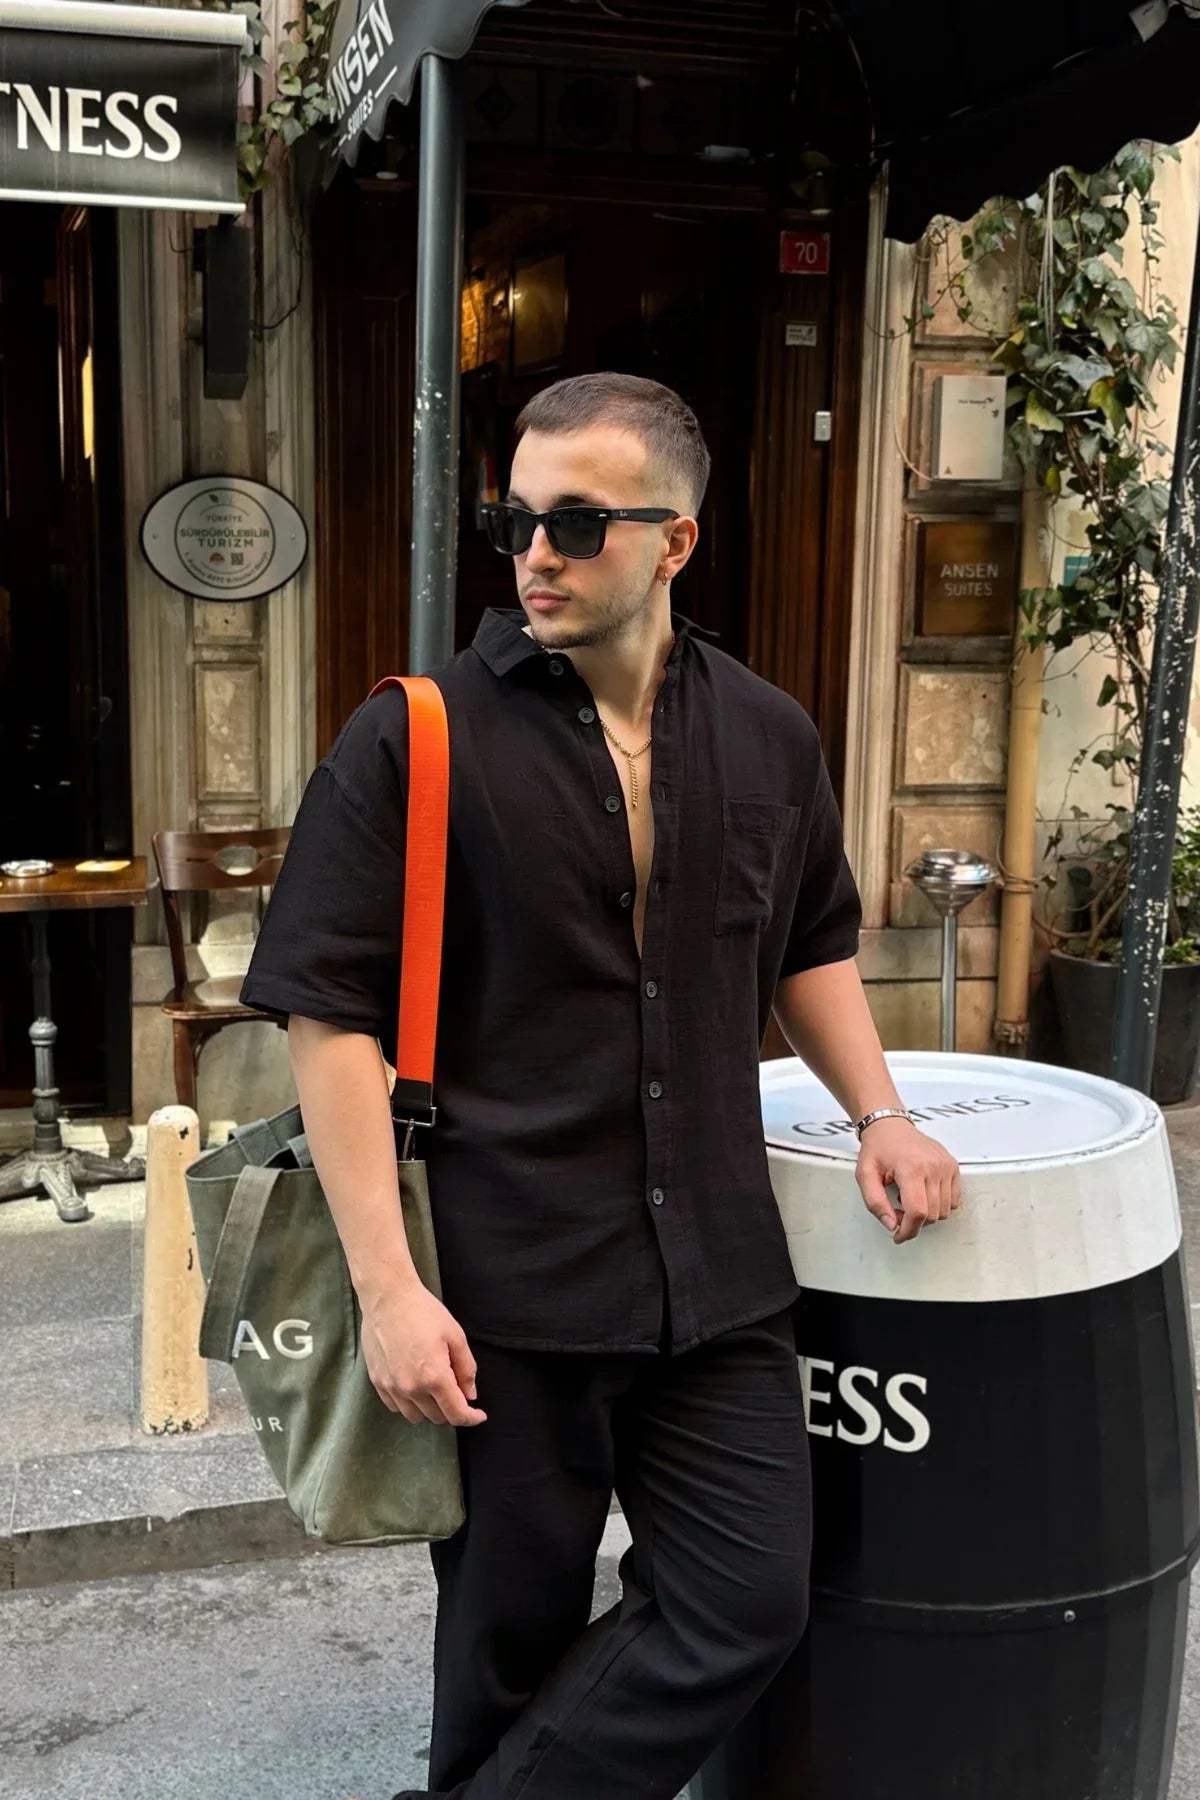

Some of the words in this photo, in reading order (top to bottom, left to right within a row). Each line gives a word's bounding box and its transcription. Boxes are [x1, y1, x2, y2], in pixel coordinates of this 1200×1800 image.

[0, 82, 182, 163] NESS
[795, 242, 818, 264] 70
[940, 563, 999, 578] ANSEN
[944, 582, 993, 597] SUITES
[791, 1094, 1031, 1137] GRTNESS
